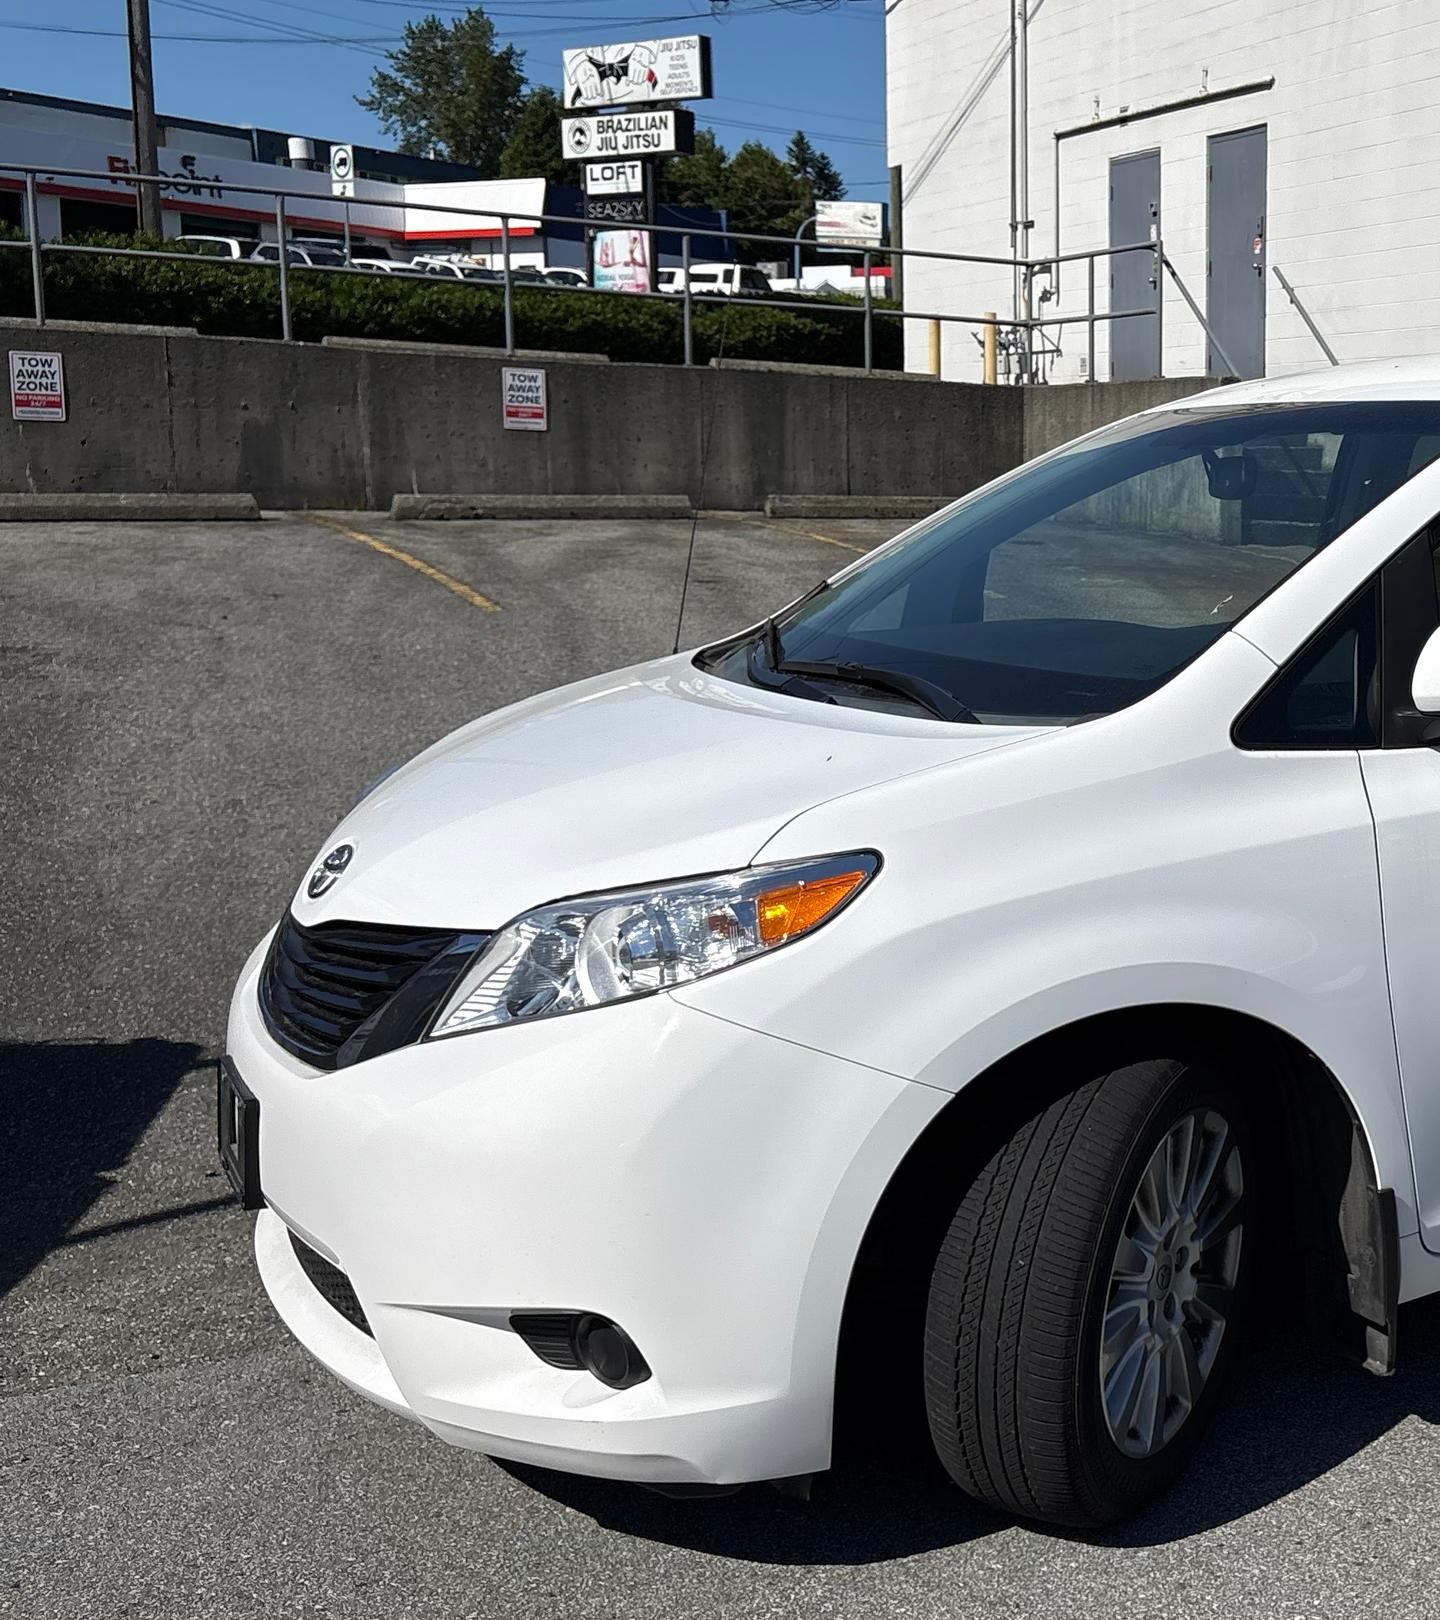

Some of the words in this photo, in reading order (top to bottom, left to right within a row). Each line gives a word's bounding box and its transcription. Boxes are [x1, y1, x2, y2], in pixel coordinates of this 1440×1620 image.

[660, 42, 673, 53] JIU
[674, 39, 697, 51] JITSU
[597, 115, 668, 135] BRAZILIAN
[597, 136, 618, 152] JIU
[622, 133, 661, 151] JITSU
[589, 164, 639, 182] LOFT
[18, 357, 53, 368] TOW
[16, 368, 57, 380] AWAY
[510, 373, 538, 383] TOW
[17, 381, 58, 392] ZONE
[508, 383, 541, 394] AWAY
[28, 394, 61, 402] PARKING
[508, 394, 541, 405] ZONE
